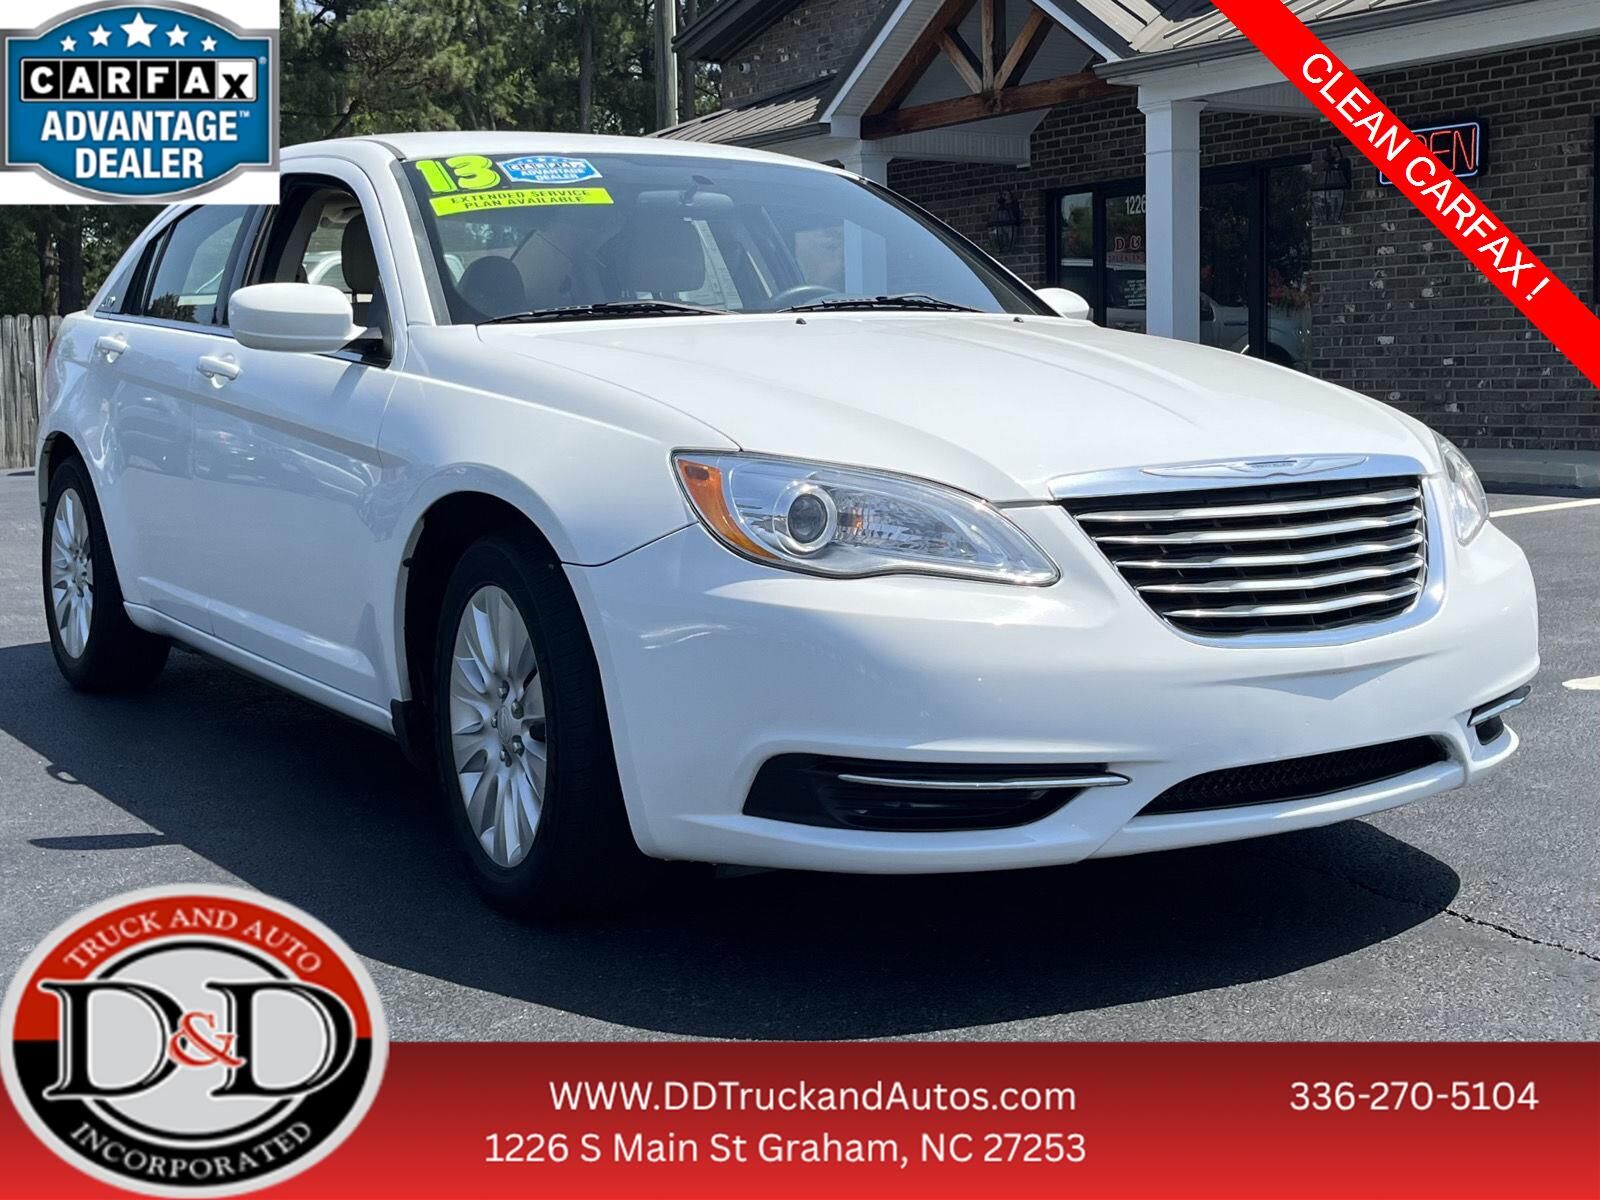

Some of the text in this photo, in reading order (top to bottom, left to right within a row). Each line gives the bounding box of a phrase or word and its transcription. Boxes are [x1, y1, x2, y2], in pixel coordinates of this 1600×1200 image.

[415, 155, 501, 193] 13
[451, 189, 591, 204] EXTENDED SERVICE
[464, 196, 584, 210] PLAN AVAILABLE
[1125, 195, 1146, 215] 1226
